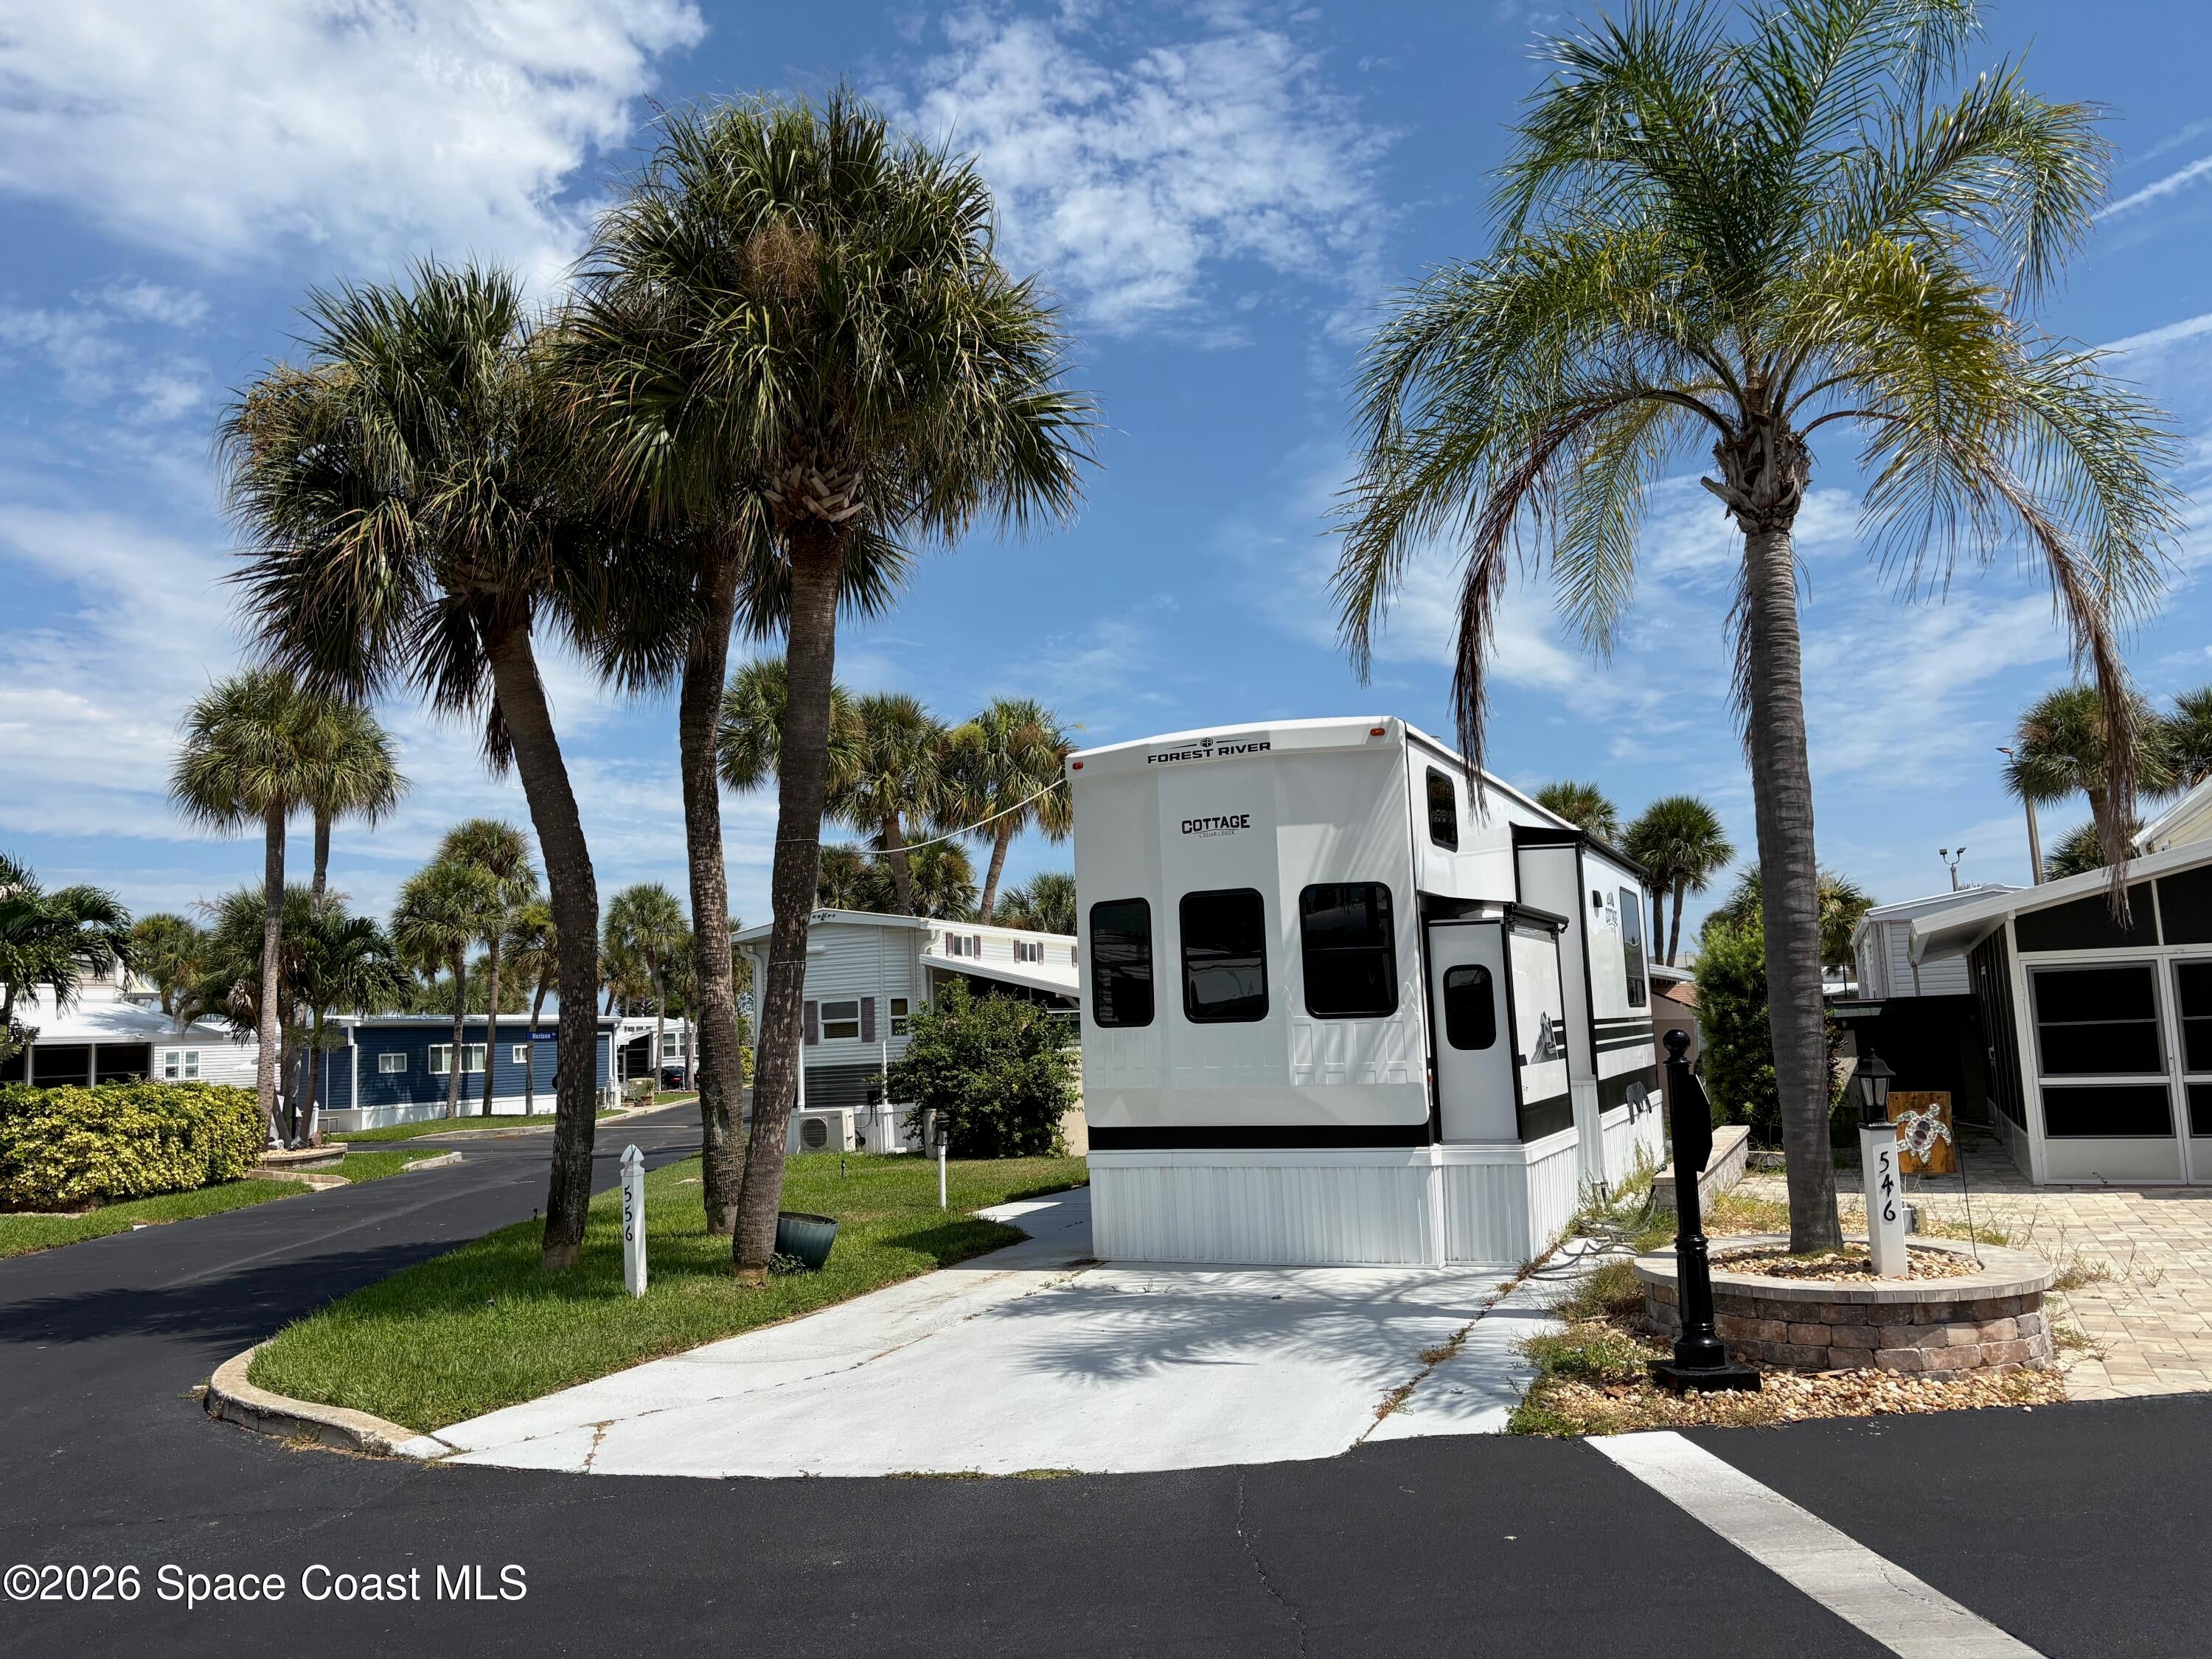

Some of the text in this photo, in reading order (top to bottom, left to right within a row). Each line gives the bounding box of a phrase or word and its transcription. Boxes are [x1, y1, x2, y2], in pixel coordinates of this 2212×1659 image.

[1147, 742, 1271, 764] FOREST RIVER
[1181, 814, 1251, 835] COTTAGE
[1879, 1151, 1896, 1222] 546
[624, 1184, 633, 1242] 556
